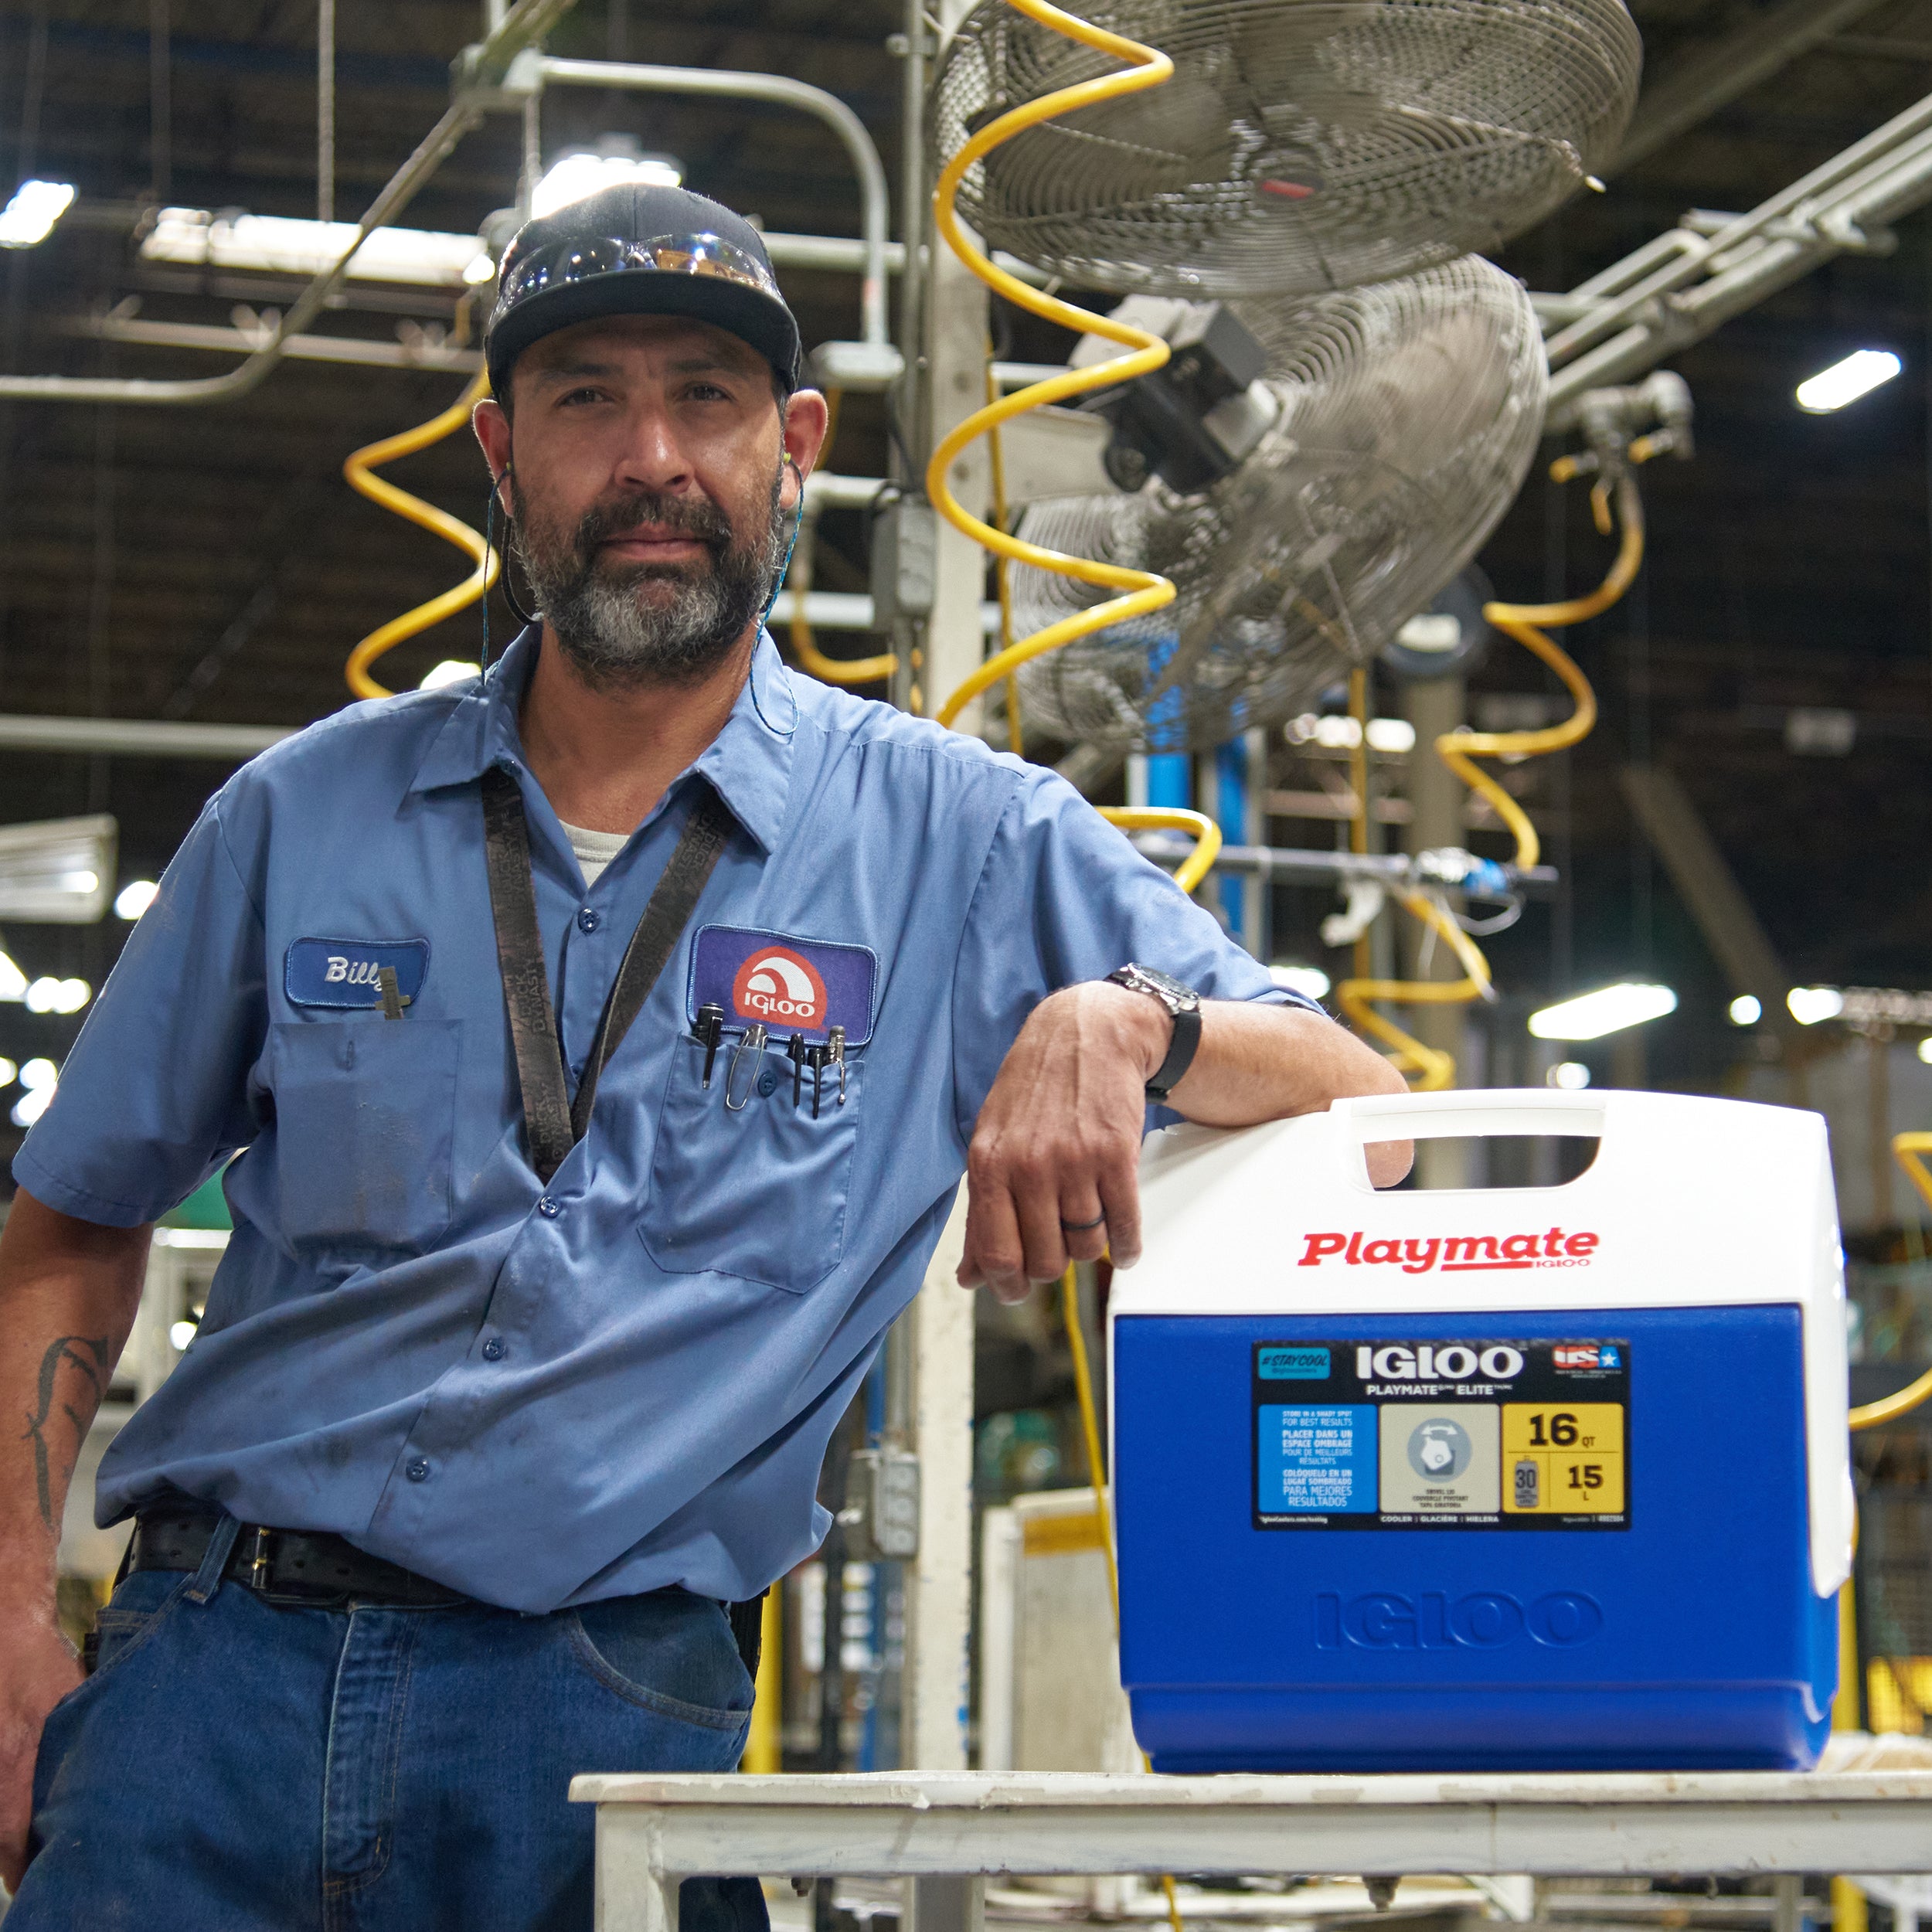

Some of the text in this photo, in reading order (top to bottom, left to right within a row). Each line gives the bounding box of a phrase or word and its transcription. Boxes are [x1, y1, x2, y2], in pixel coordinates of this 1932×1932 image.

[744, 992, 815, 1017] IGLOO
[1297, 1226, 1600, 1274] Playmate
[1536, 1259, 1590, 1268] IGLOO
[1356, 1346, 1524, 1379] IGLOO
[1282, 1417, 1353, 1427] FOR BEST RESULTS
[1282, 1430, 1353, 1438] PLACER DANS UN
[1529, 1412, 1596, 1448] 16 QT
[1282, 1439, 1312, 1447] ESPACE
[1515, 1464, 1604, 1490] 30 15
[1283, 1486, 1352, 1496] PARA MEJORES
[1583, 1491, 1590, 1501] L
[1288, 1496, 1348, 1507] RESULTADOS
[1316, 1590, 1605, 1651] IGLOO
